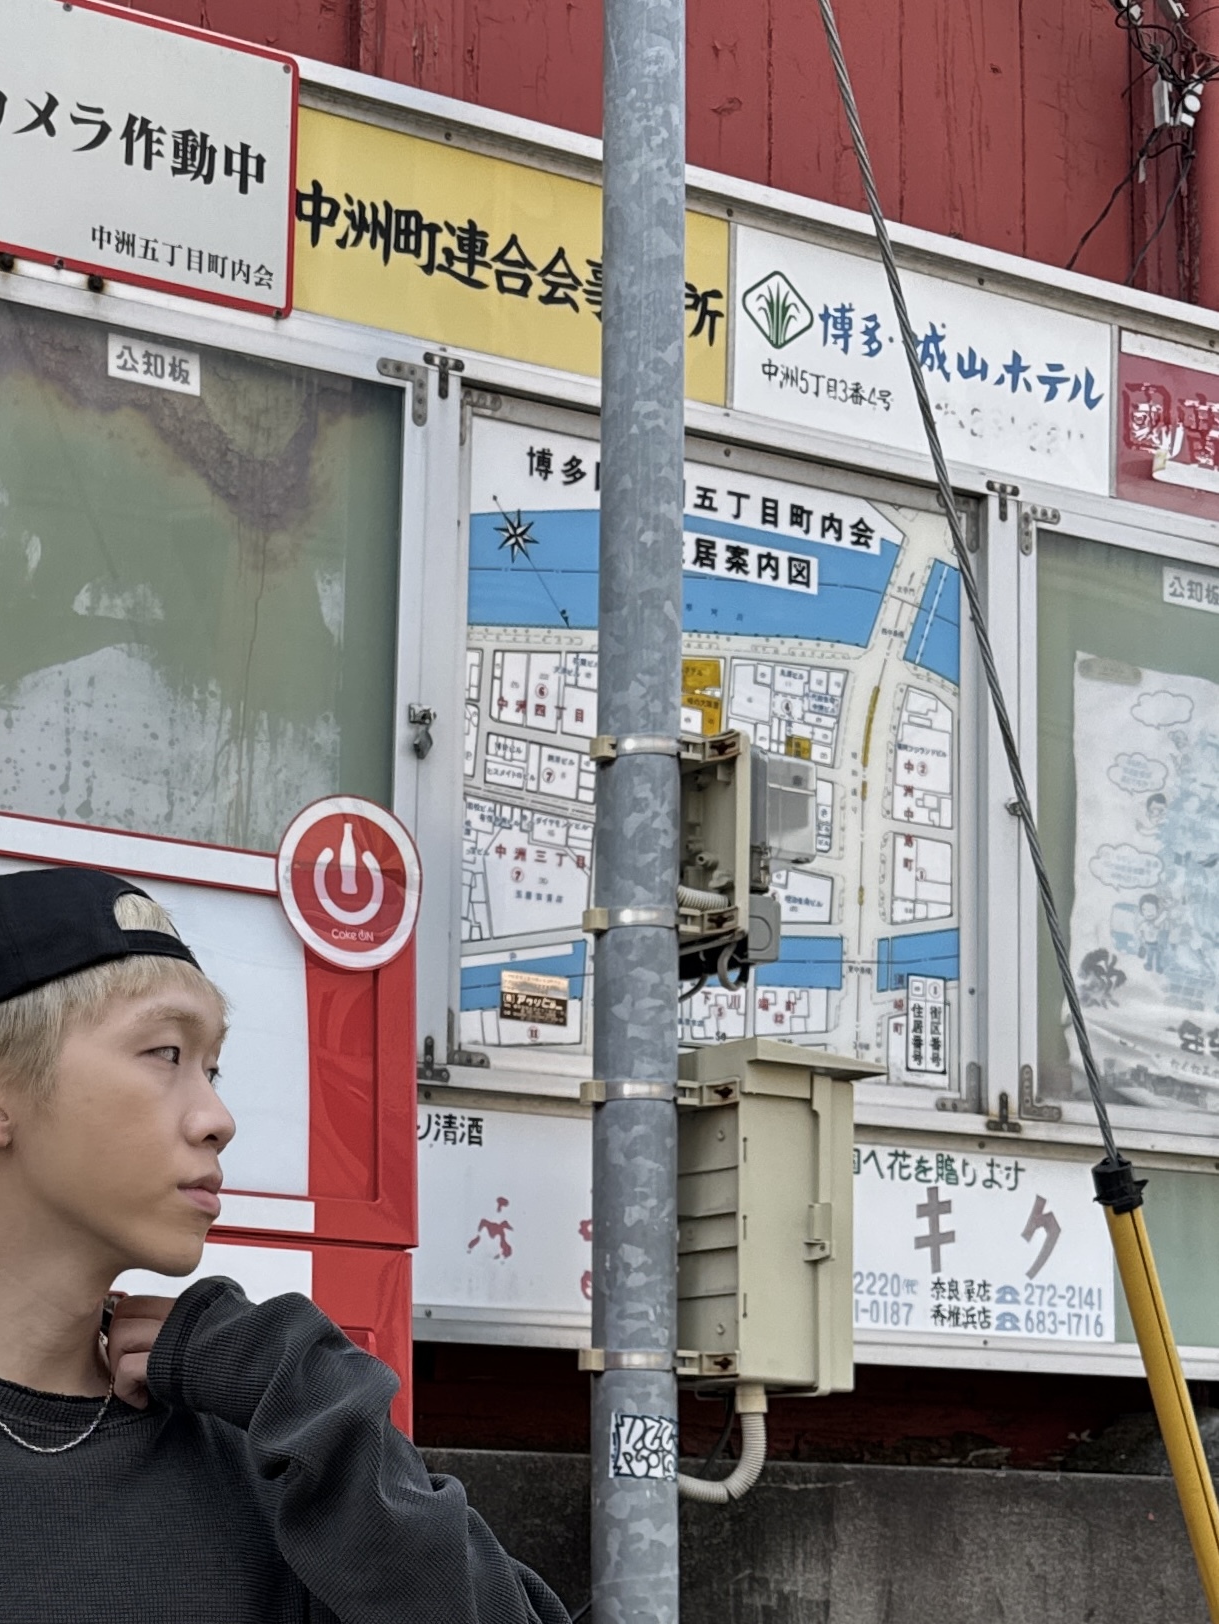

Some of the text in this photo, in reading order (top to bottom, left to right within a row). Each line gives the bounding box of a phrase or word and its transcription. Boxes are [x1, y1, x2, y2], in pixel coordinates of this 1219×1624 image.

[90, 224, 275, 291] 中洲五丁目町内会
[295, 179, 725, 347] 中洲町連合会所
[116, 342, 193, 387] 公知板
[526, 446, 875, 550] 博多五丁目町内会
[682, 536, 812, 589] 居案内図
[331, 927, 357, 942] Coke
[1024, 1283, 1103, 1312] 272-2141
[1024, 1310, 1104, 1338] 683-1716
